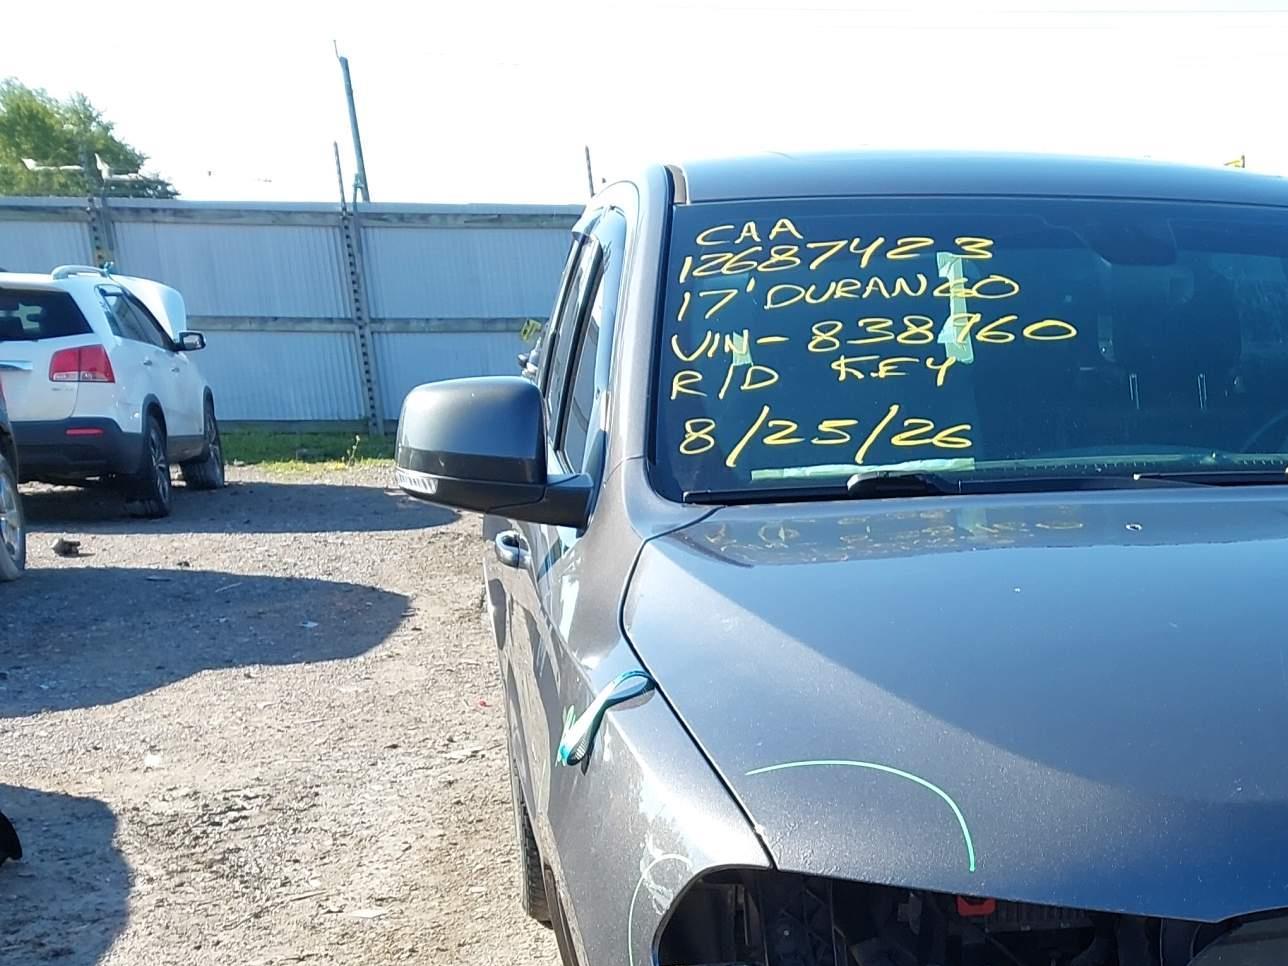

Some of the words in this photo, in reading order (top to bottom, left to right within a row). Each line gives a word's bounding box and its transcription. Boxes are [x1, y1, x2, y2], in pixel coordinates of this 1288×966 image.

[695, 217, 804, 246] CAA
[679, 236, 995, 283] 12687423
[764, 274, 1021, 309] DURANGO
[671, 366, 780, 401] R/D
[830, 354, 957, 387] KEY
[679, 404, 974, 468] 8/25/26
